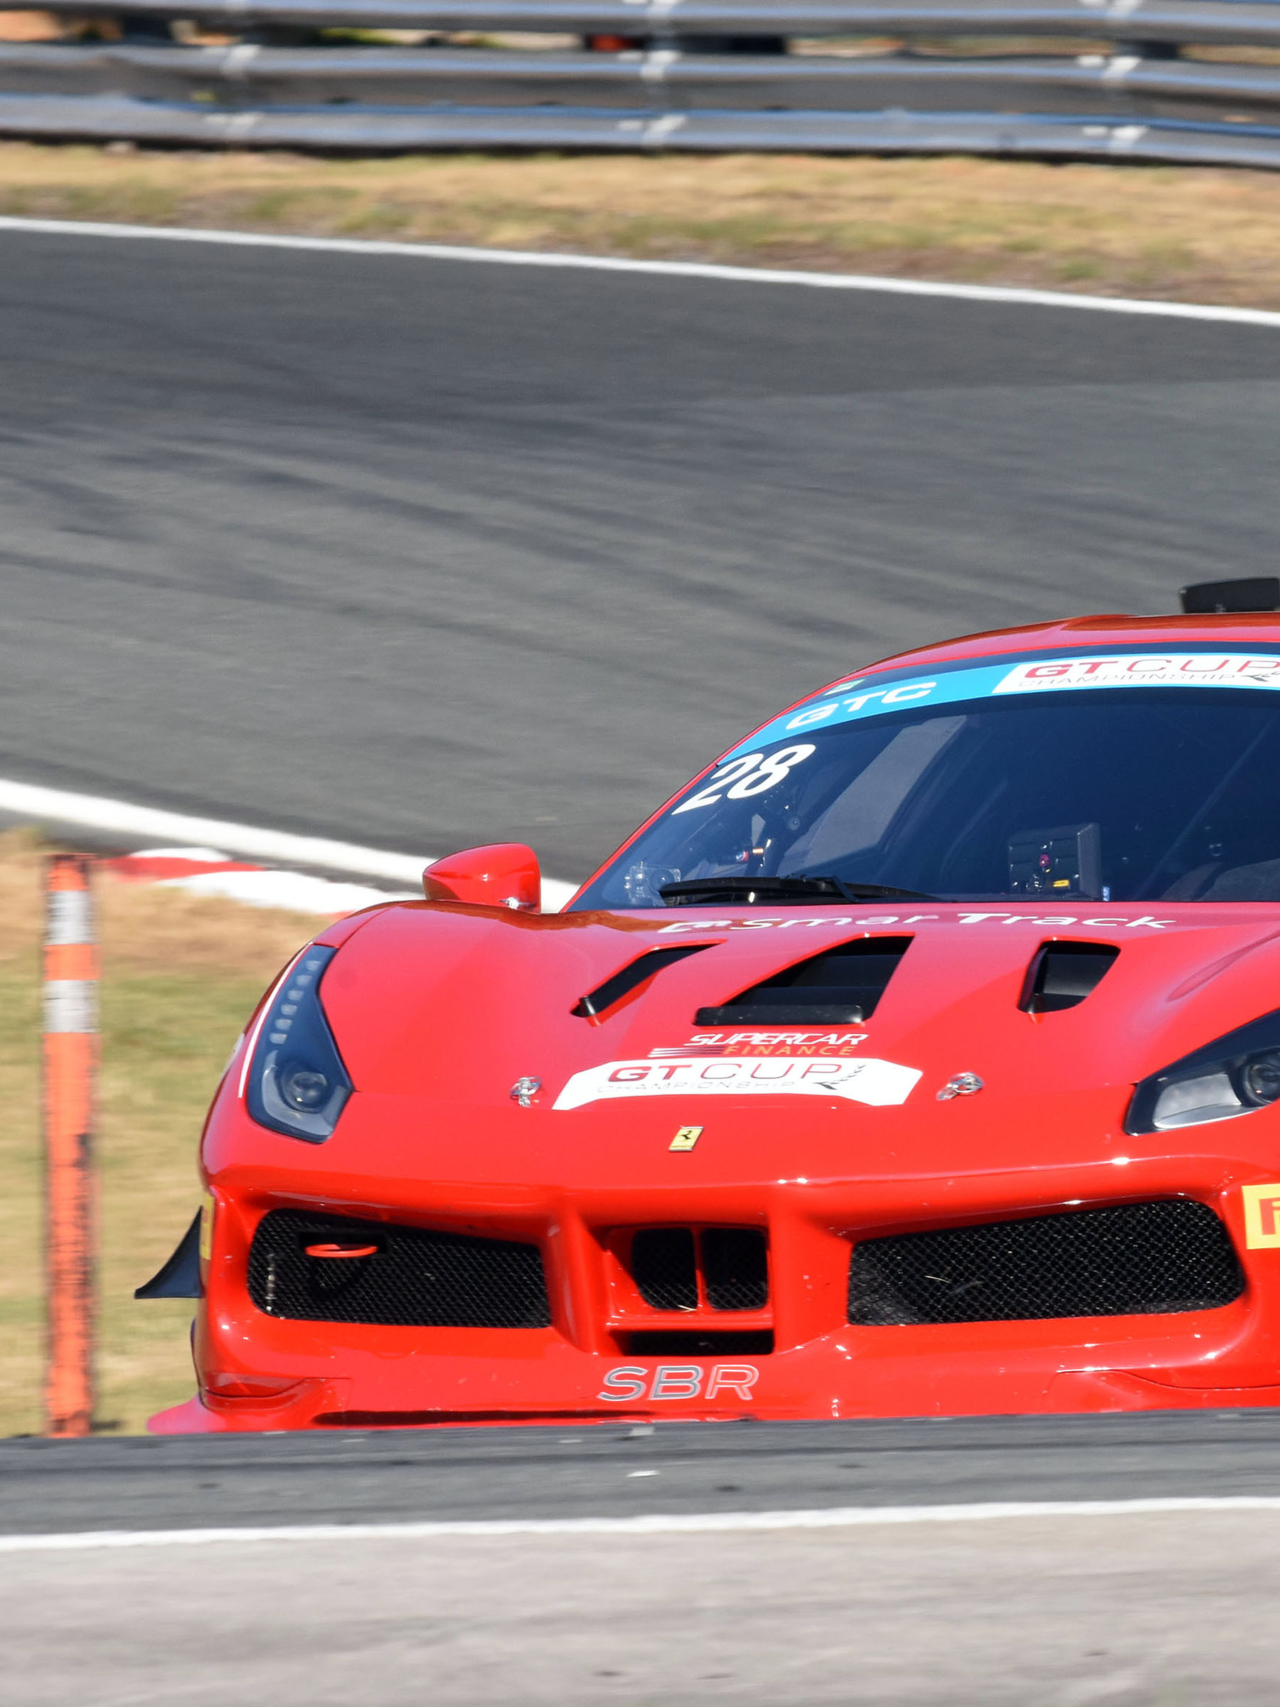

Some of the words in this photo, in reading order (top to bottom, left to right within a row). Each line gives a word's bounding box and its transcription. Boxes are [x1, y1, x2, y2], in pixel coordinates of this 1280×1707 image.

[1024, 660, 1120, 678] GT
[1018, 672, 1236, 687] CHAMPIONSHIP
[785, 682, 937, 730] GTC
[671, 744, 816, 815] 28
[957, 913, 1177, 929] Track
[683, 1032, 869, 1046] SUPERCAR
[722, 1045, 857, 1056] FINANCE
[607, 1064, 693, 1082] GT
[699, 1063, 843, 1080] CUP
[597, 1080, 796, 1093] CHAMPIONSHIP
[596, 1364, 760, 1401] SBR
